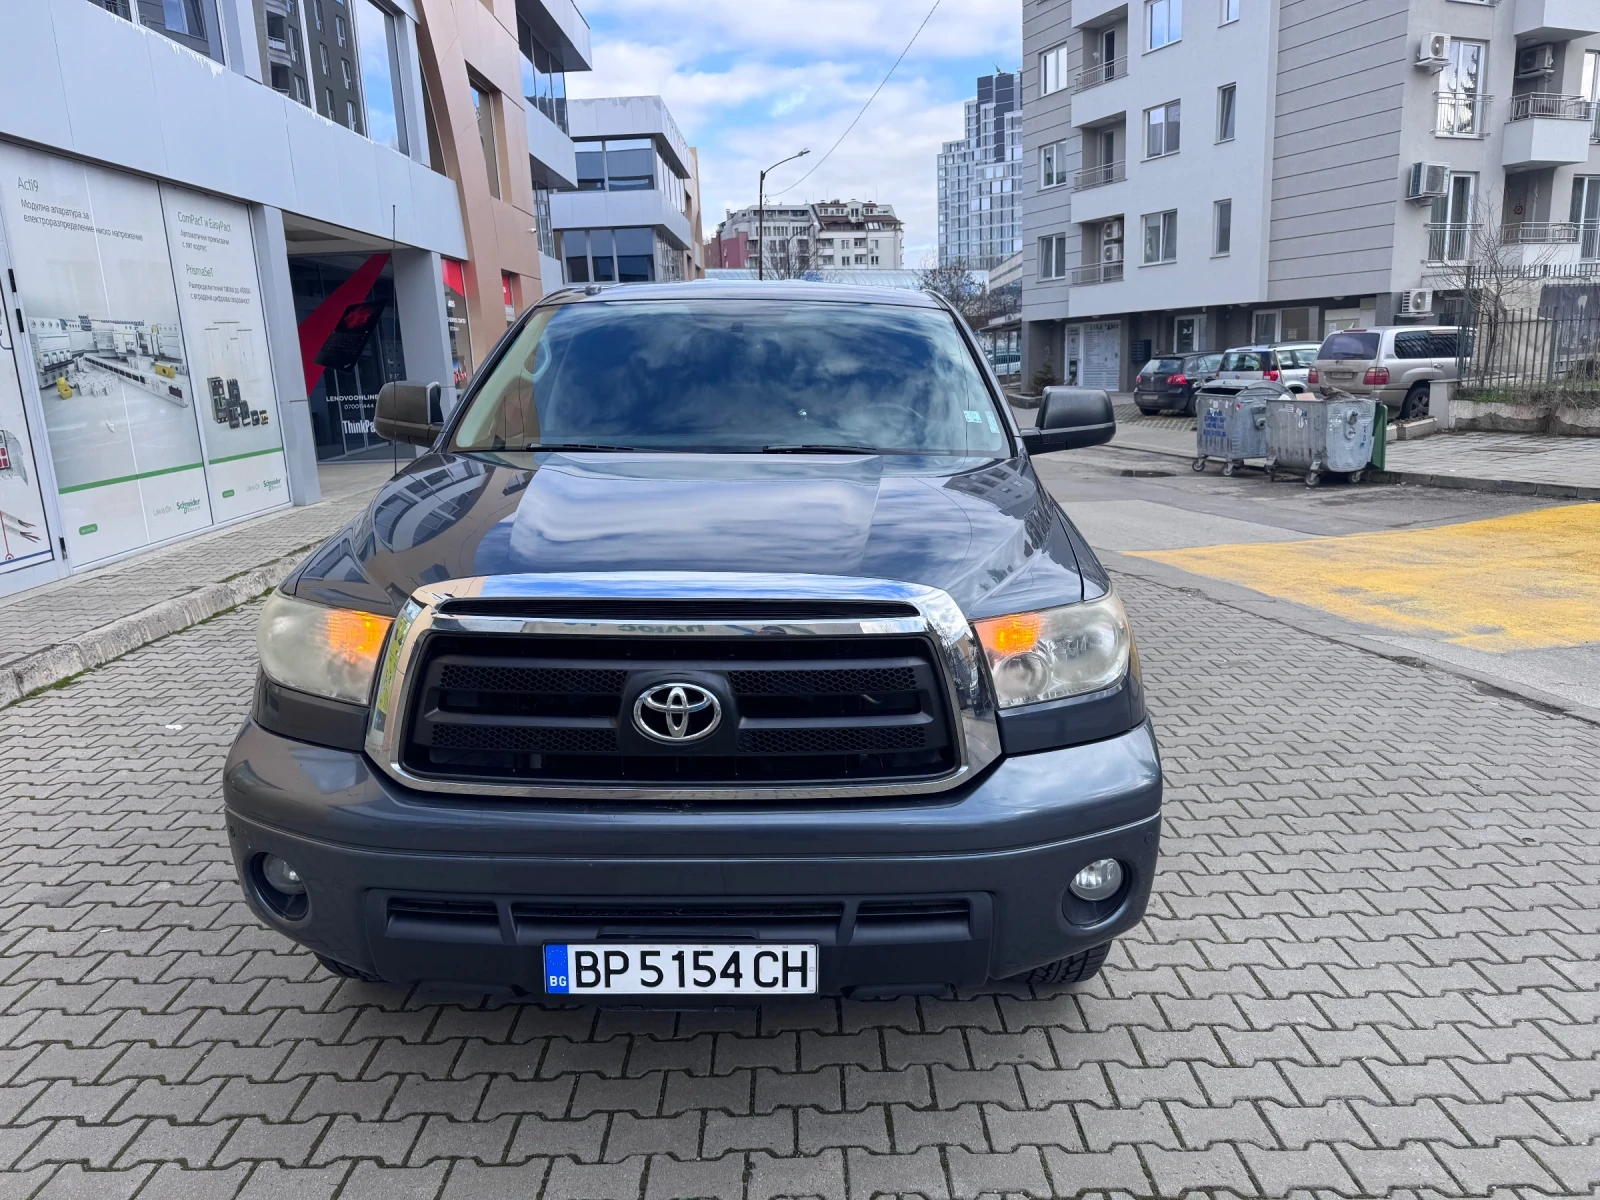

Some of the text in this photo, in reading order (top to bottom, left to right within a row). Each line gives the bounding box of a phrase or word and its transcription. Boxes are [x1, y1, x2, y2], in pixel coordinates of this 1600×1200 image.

[18, 177, 39, 192] Acti9
[21, 198, 90, 220] Модулна апаратура за
[24, 214, 95, 233] електроразпределение
[342, 420, 376, 434] ThinkPa
[176, 497, 201, 510] Schneider
[575, 950, 808, 988] BP 5154 CH
[550, 975, 567, 987] BG
